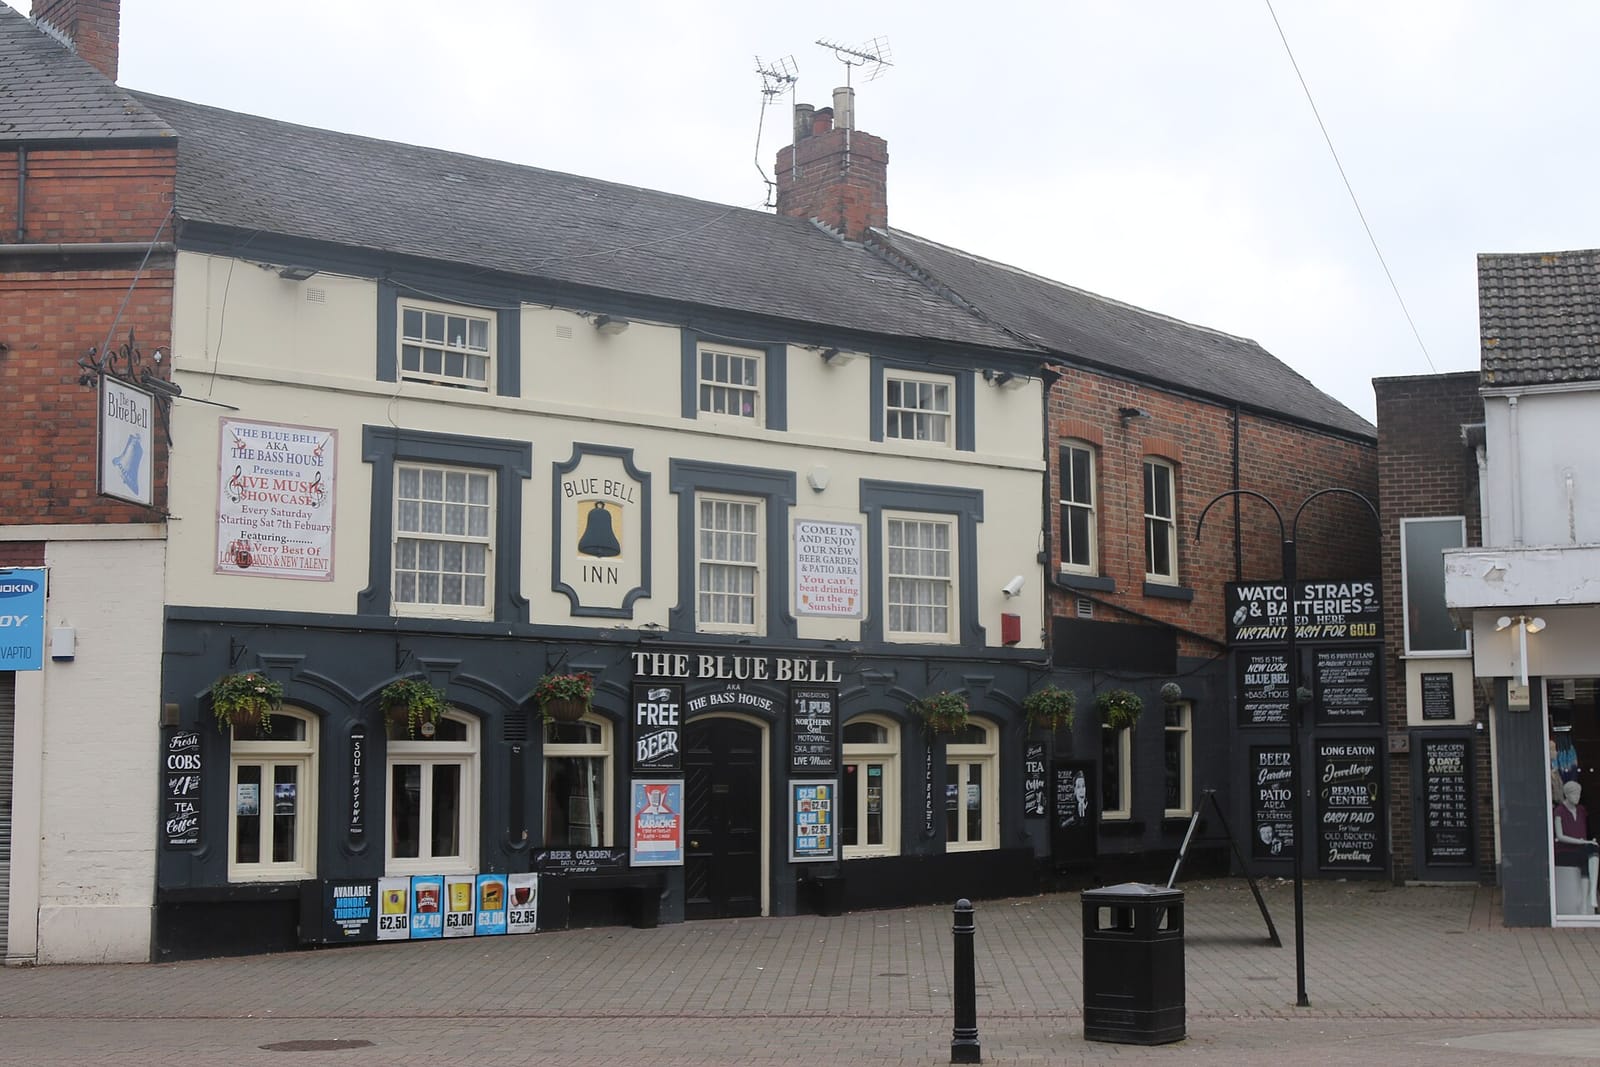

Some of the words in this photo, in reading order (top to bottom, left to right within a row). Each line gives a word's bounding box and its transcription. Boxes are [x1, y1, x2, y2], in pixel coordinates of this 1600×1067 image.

[119, 392, 129, 405] The
[108, 392, 130, 422] Blue
[130, 400, 148, 429] Bell
[235, 428, 258, 438] THE
[261, 430, 290, 441] BLUE
[292, 434, 318, 444] BELL
[266, 442, 289, 451] AKA
[231, 448, 254, 460] THE
[258, 450, 283, 463] BASS
[286, 454, 324, 467] HOUSE
[254, 465, 294, 477] Presents
[232, 475, 269, 489] LIVE
[273, 478, 324, 495] MUSIC
[564, 478, 598, 498] BLUE
[604, 480, 634, 504] BELL
[240, 490, 313, 506] SHOWCASE
[242, 505, 269, 517] Every
[271, 508, 313, 520] Saturday
[221, 514, 258, 529] Starting
[260, 518, 274, 527] Sat
[277, 520, 292, 529] 7th
[295, 521, 331, 534] Febuary
[802, 526, 837, 536] COME
[840, 528, 853, 536] IN
[799, 535, 822, 544] AND
[824, 536, 856, 547] ENJOY
[254, 544, 279, 554] Very
[282, 546, 304, 555] Best
[307, 546, 321, 556] Of
[803, 545, 827, 554] OUR
[274, 558, 279, 566] &
[280, 556, 298, 568] NEW
[300, 557, 329, 570] TALENT
[799, 554, 821, 563] BEER
[823, 556, 858, 566] GARDEN
[584, 566, 618, 585] INN
[801, 564, 808, 572] &
[809, 565, 835, 573] PATIO
[837, 567, 857, 575] AREA
[803, 575, 824, 584] You
[827, 577, 854, 585] can't
[800, 584, 818, 593] beat
[820, 585, 858, 597] drinking
[1305, 583, 1375, 600] STRAPS
[828, 594, 843, 603] the
[808, 602, 853, 612] Sunshine
[1250, 601, 1263, 617] &
[1269, 616, 1309, 627] FITED
[1317, 615, 1346, 625] HERE
[1322, 625, 1347, 638] FOR
[1350, 624, 1376, 637] GOLD
[1, 646, 32, 660] VAPTIO
[632, 652, 690, 678] THE
[696, 654, 770, 681] BLUE
[775, 658, 842, 683] BELL
[1248, 664, 1266, 673] NEW
[1245, 673, 1270, 685] BLUE
[1271, 674, 1289, 685] BEL
[688, 696, 708, 712] THE
[710, 692, 736, 705] BASS
[808, 701, 831, 714] PUB
[637, 703, 679, 726] FREE
[795, 718, 832, 726] NORTHERN
[170, 736, 198, 749] Fresh
[637, 731, 679, 762] BEER
[1321, 746, 1345, 756] LONG
[1347, 746, 1375, 756] EATON
[167, 754, 201, 770] COBS
[353, 742, 361, 775] SOUL
[794, 757, 808, 766] LIVE
[809, 756, 833, 766] Music
[1259, 753, 1291, 766] BEER
[1026, 761, 1045, 773] TEA
[1322, 764, 1374, 783] Jewellery
[1257, 768, 1292, 786] Garden
[1026, 779, 1045, 792] Coffee
[1331, 786, 1368, 796] REPAIR
[352, 779, 360, 824] MOTOWN
[1260, 789, 1292, 801] PATIO
[1329, 796, 1369, 806] CENTRE
[174, 802, 194, 812] TEA
[1264, 801, 1286, 809] AREA
[638, 819, 677, 829] KARAOKE
[1323, 812, 1349, 823] CASH
[1349, 812, 1375, 823] PAID
[166, 818, 197, 834] Coffee
[1329, 841, 1374, 850] UNWANTED
[550, 850, 572, 860] BEER
[576, 850, 611, 859] GARDEN
[1328, 849, 1372, 863] Jewellery
[333, 886, 372, 898] AVAILABLE
[333, 907, 372, 919] THURSDAY
[479, 912, 505, 926] £3.00
[510, 910, 535, 924] £2.95
[380, 916, 407, 930] £2.50
[413, 914, 441, 929] £2.40
[447, 914, 473, 927] £3.00
